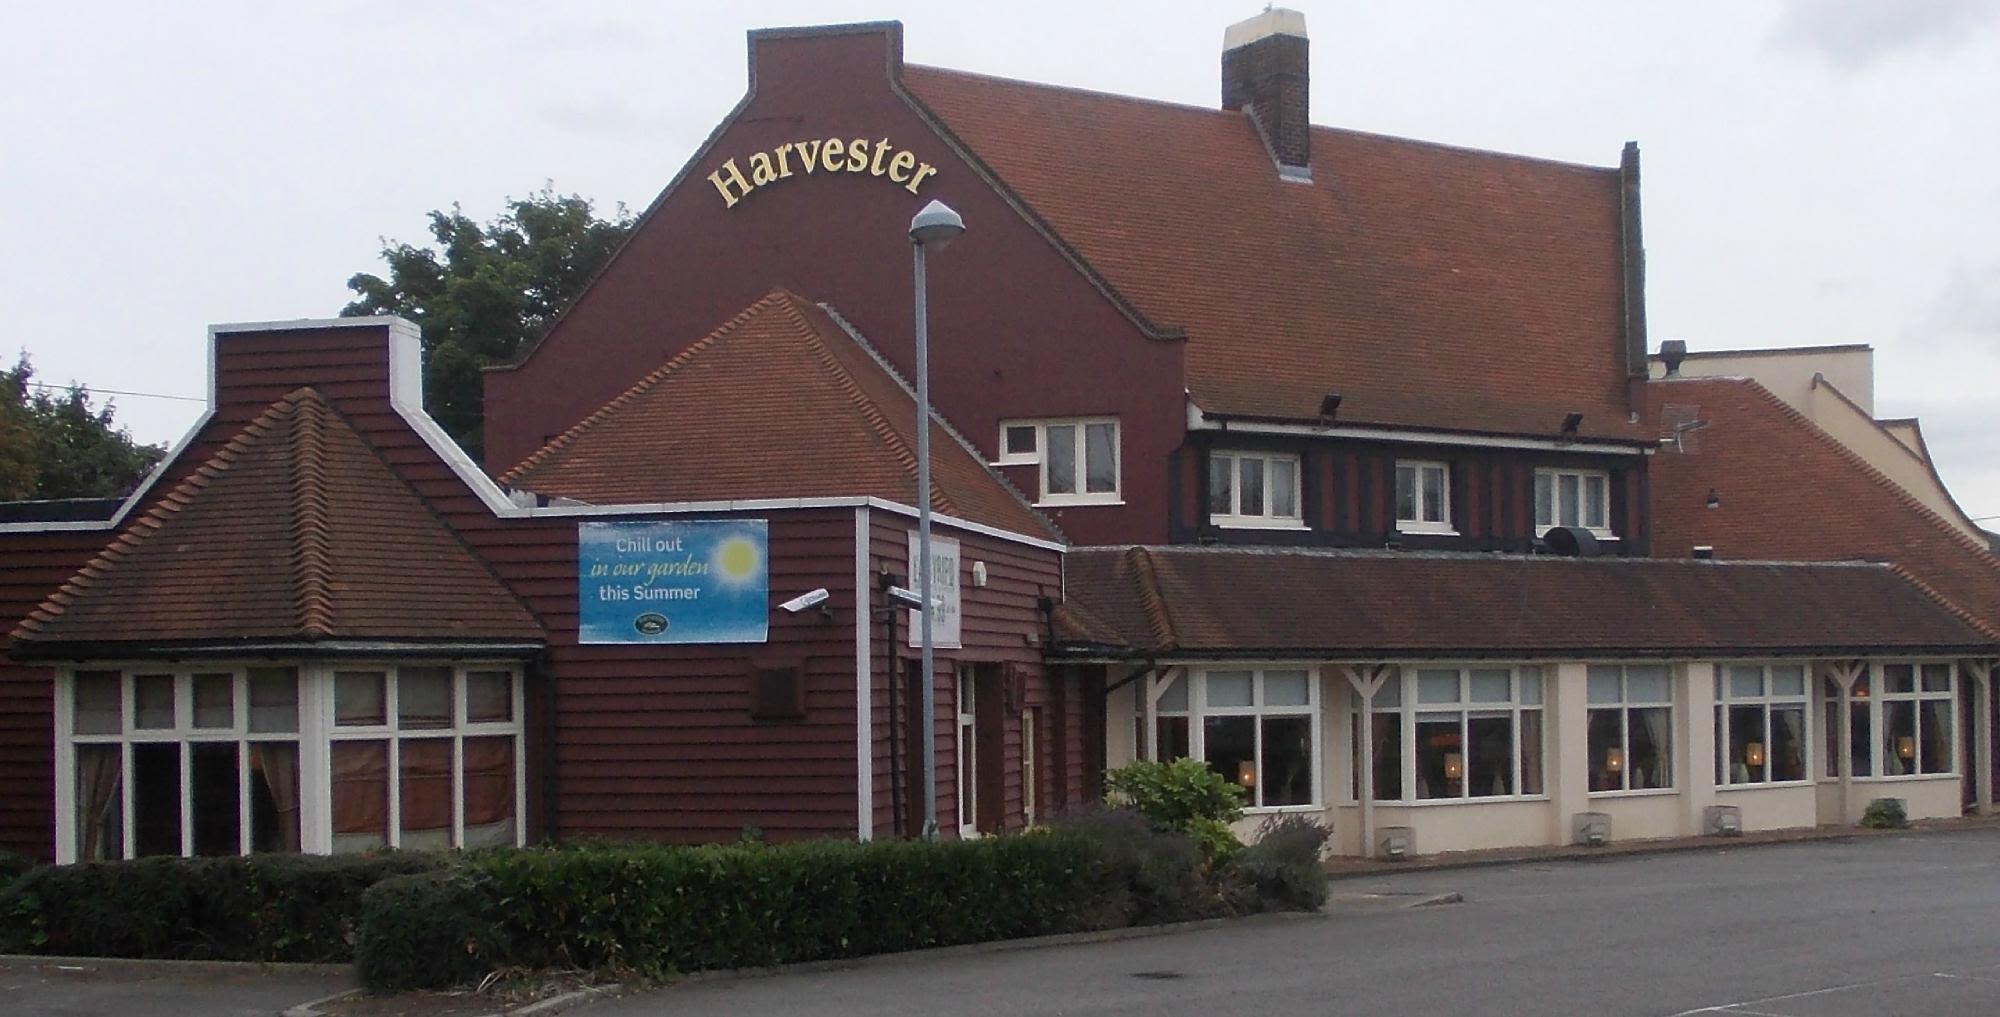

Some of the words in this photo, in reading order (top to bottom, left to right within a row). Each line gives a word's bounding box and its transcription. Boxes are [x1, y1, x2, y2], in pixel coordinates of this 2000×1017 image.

[706, 136, 938, 209] Harvester
[616, 536, 650, 552] Chill
[656, 536, 683, 552] out
[591, 557, 609, 577] in
[613, 561, 643, 577] our
[645, 553, 709, 586] garden
[600, 585, 630, 601] this
[634, 585, 701, 601] Summer
